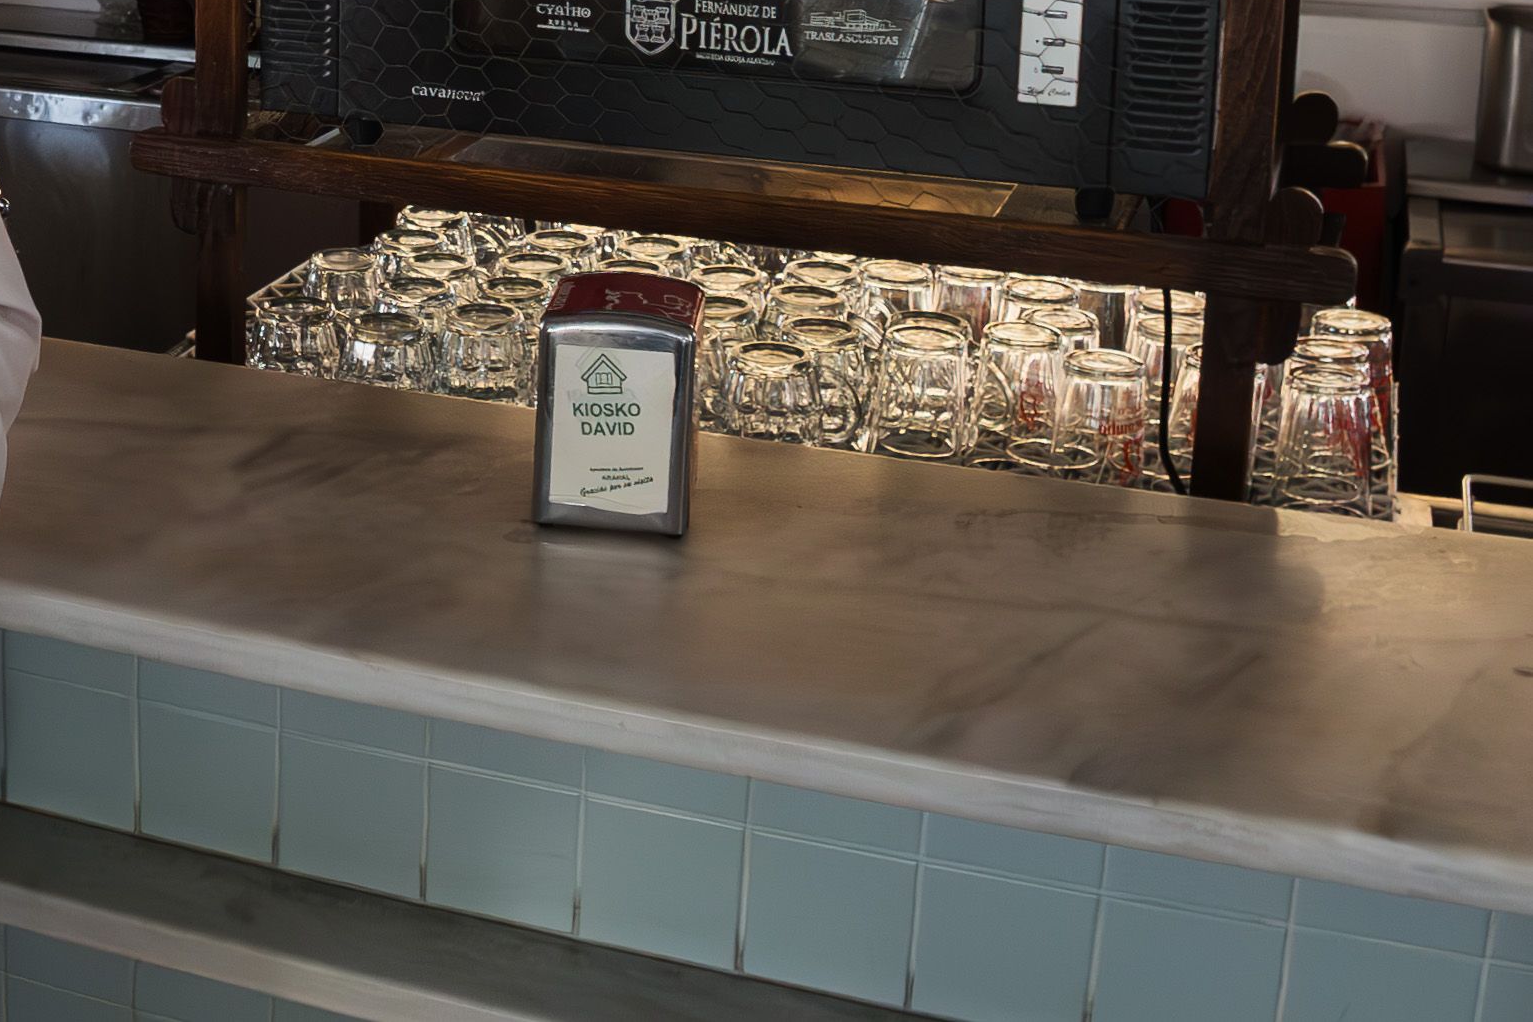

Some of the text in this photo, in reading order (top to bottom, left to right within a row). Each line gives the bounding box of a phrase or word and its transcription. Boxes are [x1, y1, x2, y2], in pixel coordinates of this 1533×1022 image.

[761, 4, 778, 19] DE
[680, 13, 794, 57] PIÉROLA
[572, 402, 642, 418] KIOSKO
[581, 421, 635, 436] DAVID
